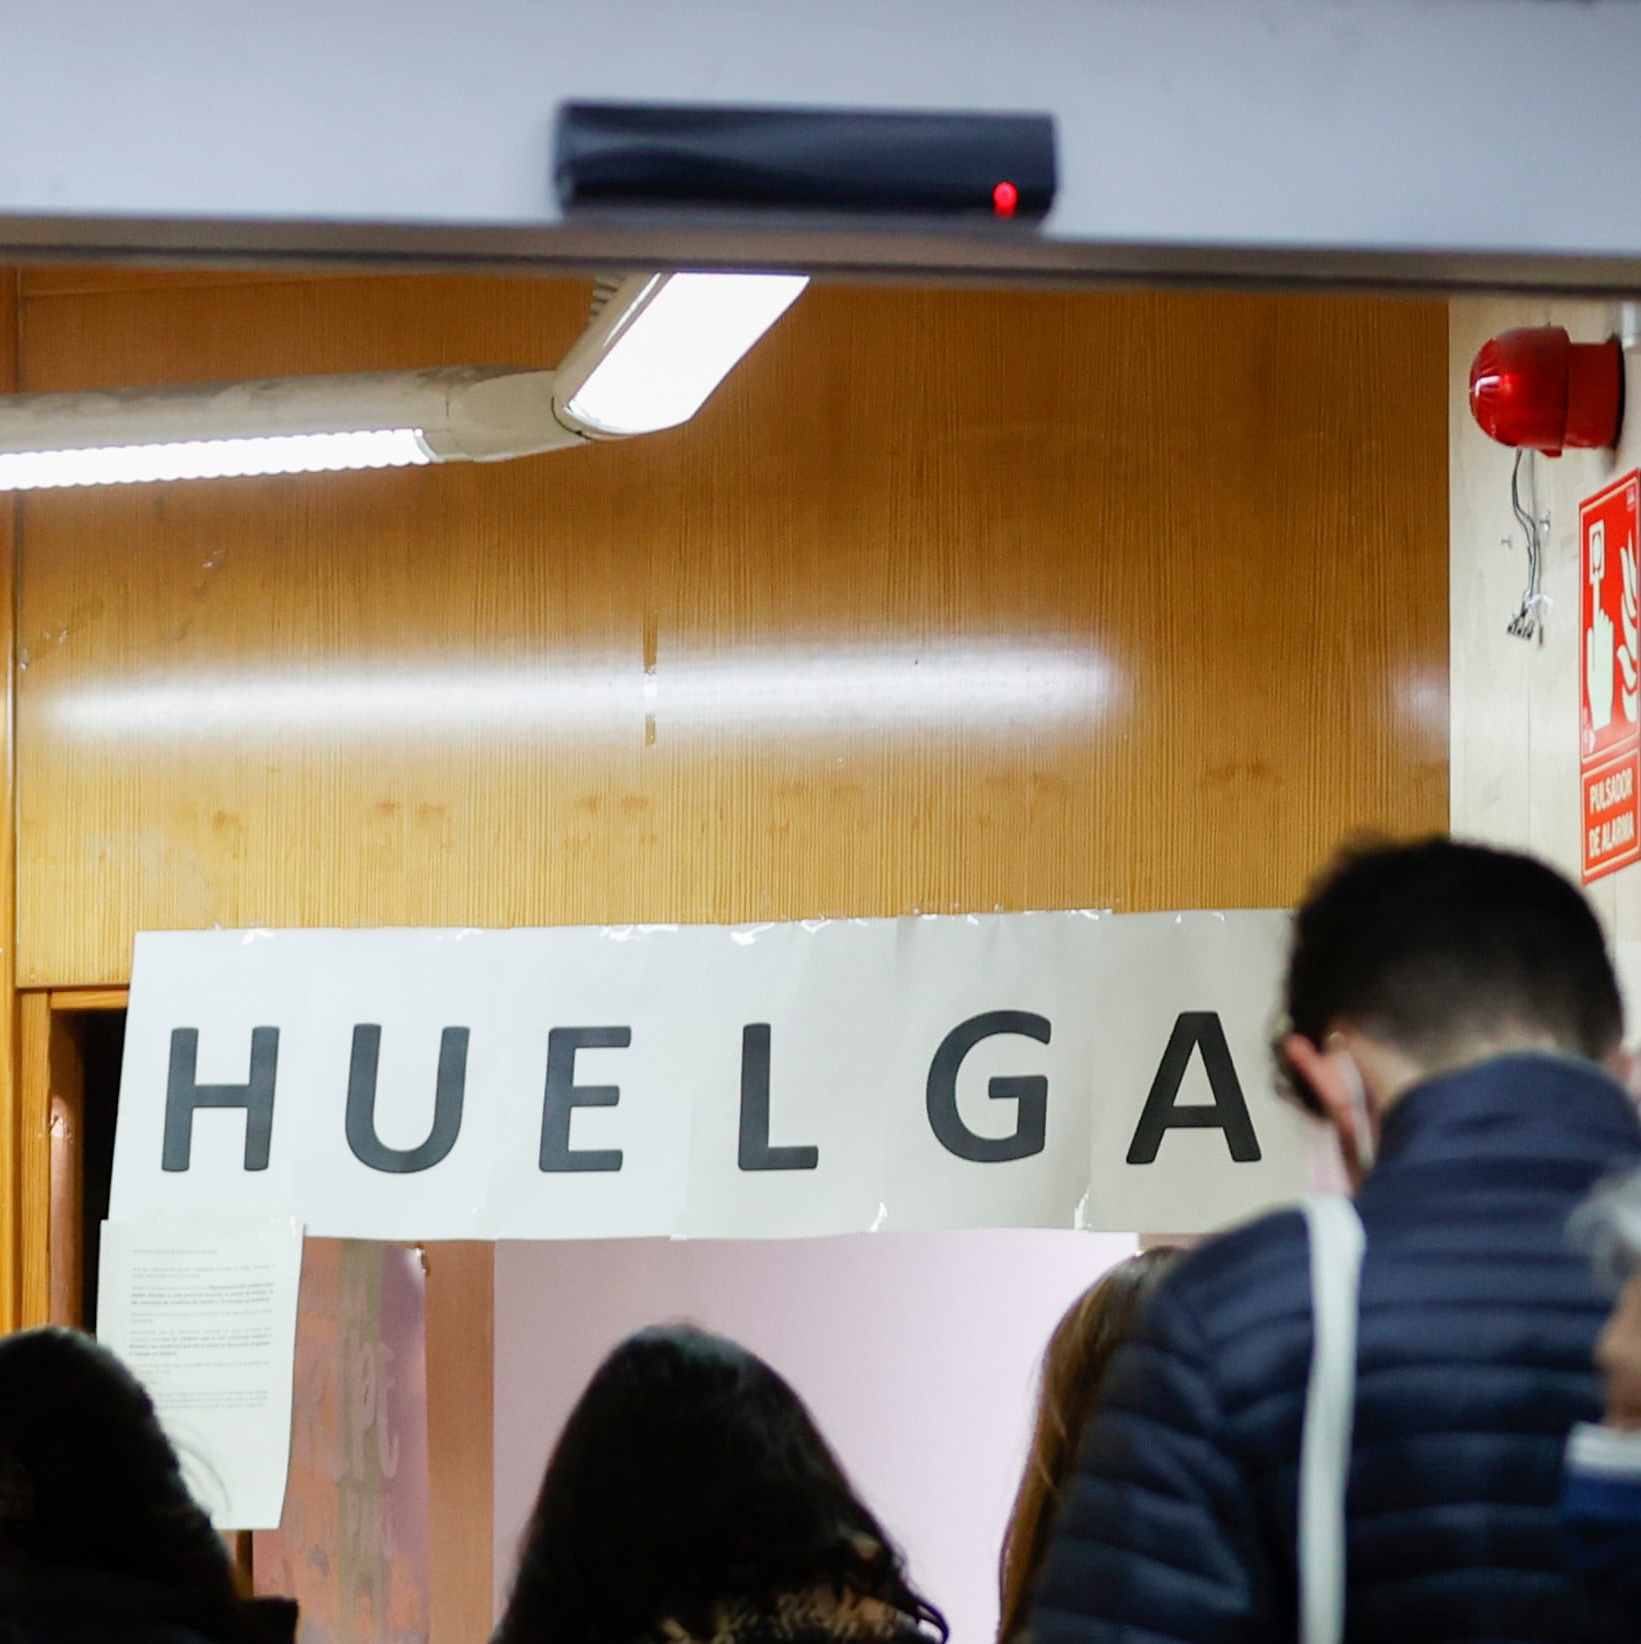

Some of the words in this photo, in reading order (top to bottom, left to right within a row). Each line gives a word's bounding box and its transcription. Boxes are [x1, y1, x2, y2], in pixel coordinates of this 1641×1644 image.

[1589, 767, 1633, 815] PULSADOR
[1589, 825, 1601, 859] DE
[1602, 811, 1635, 853] ALARMA
[161, 1009, 1262, 1174] HUELGA
